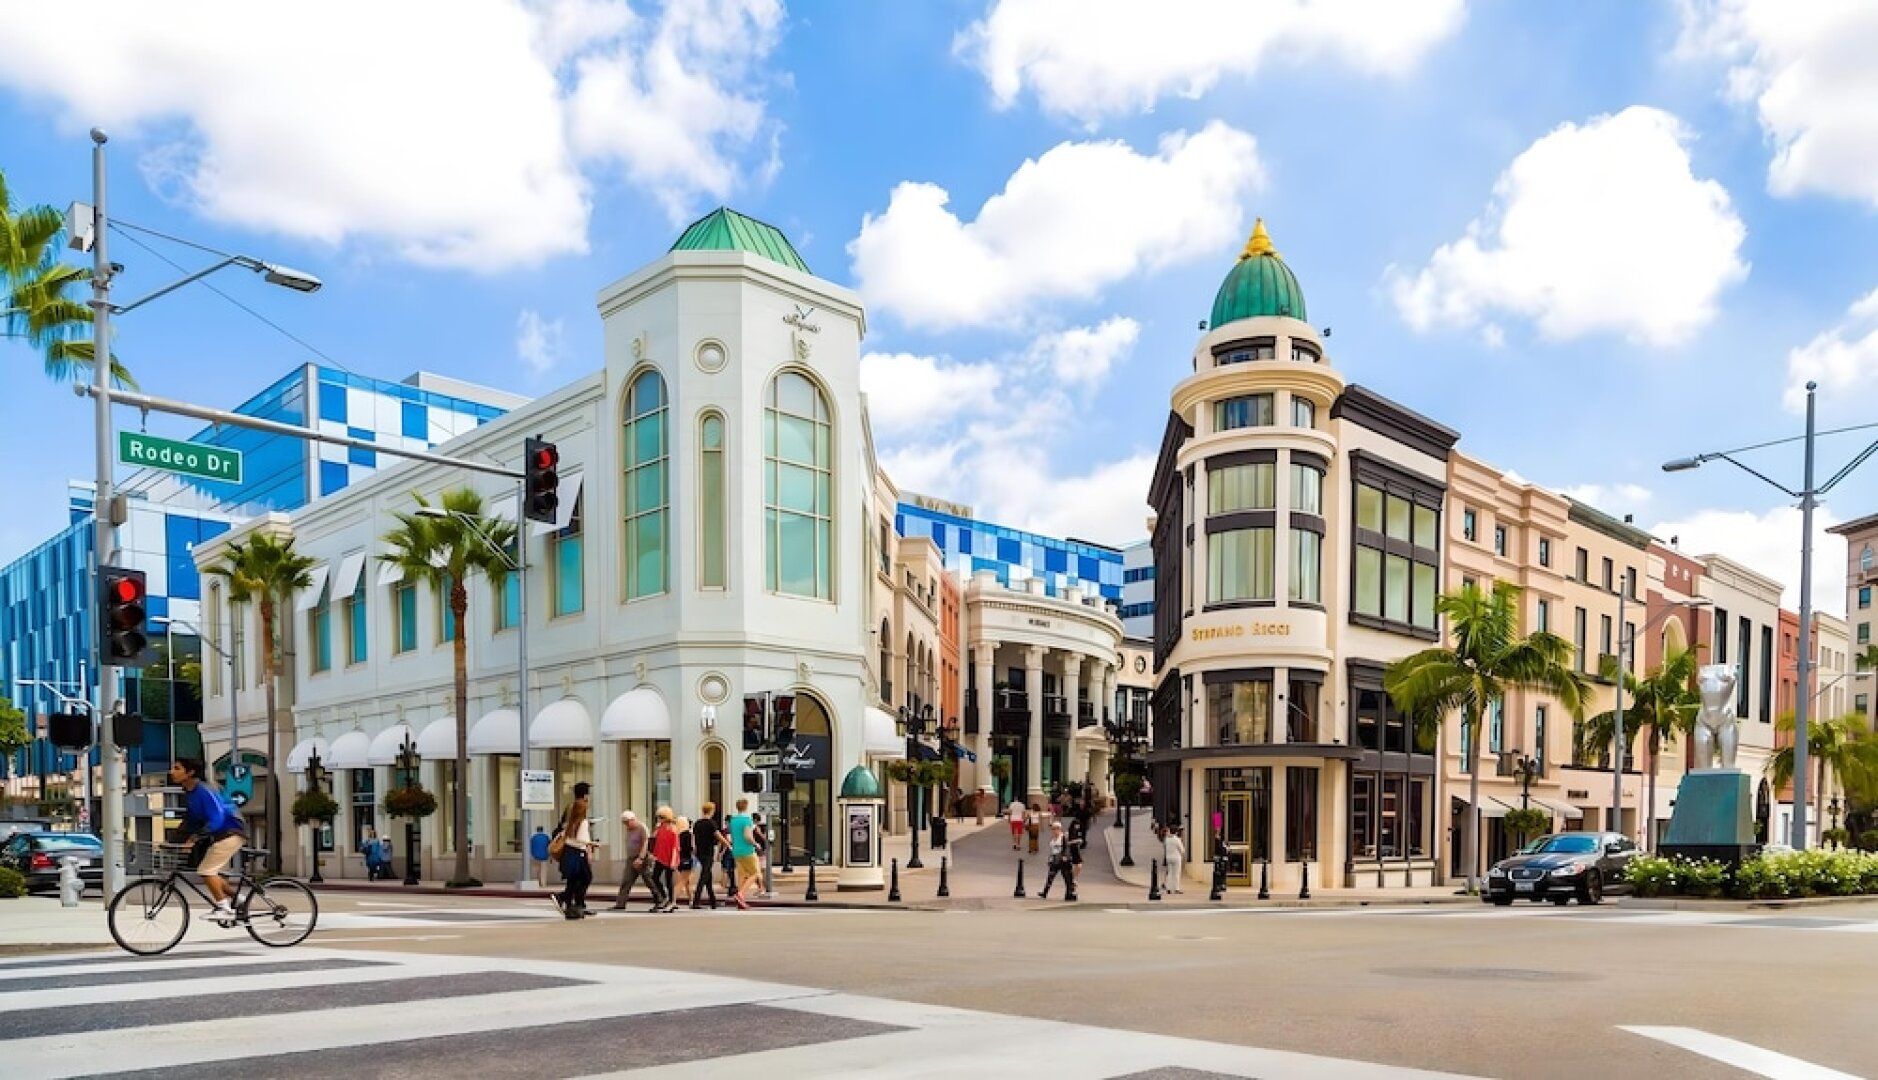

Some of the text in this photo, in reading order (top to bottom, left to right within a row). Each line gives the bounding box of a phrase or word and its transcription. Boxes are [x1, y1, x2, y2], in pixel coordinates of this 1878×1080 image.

[129, 440, 232, 474] Rodeo Dr
[1192, 624, 1244, 641] STEFANO
[234, 766, 247, 779] P
